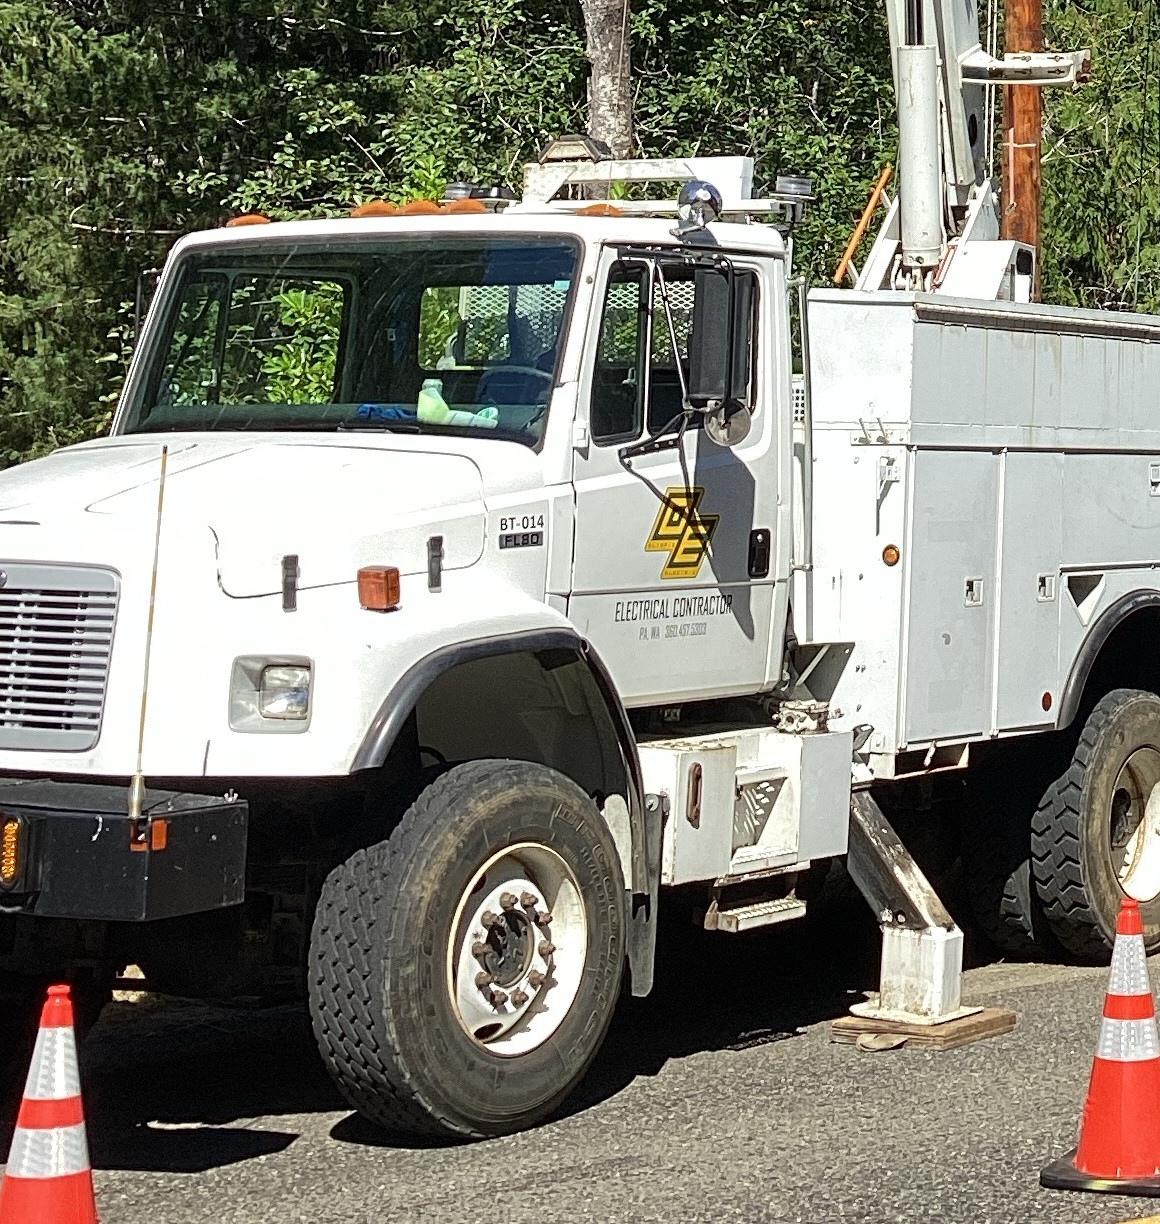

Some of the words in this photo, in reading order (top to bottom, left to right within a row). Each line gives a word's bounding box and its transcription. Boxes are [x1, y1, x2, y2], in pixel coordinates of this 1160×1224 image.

[500, 515, 544, 531] BT-014
[615, 598, 670, 622] ELECTRICAL
[673, 594, 733, 618] CONTRACTOR
